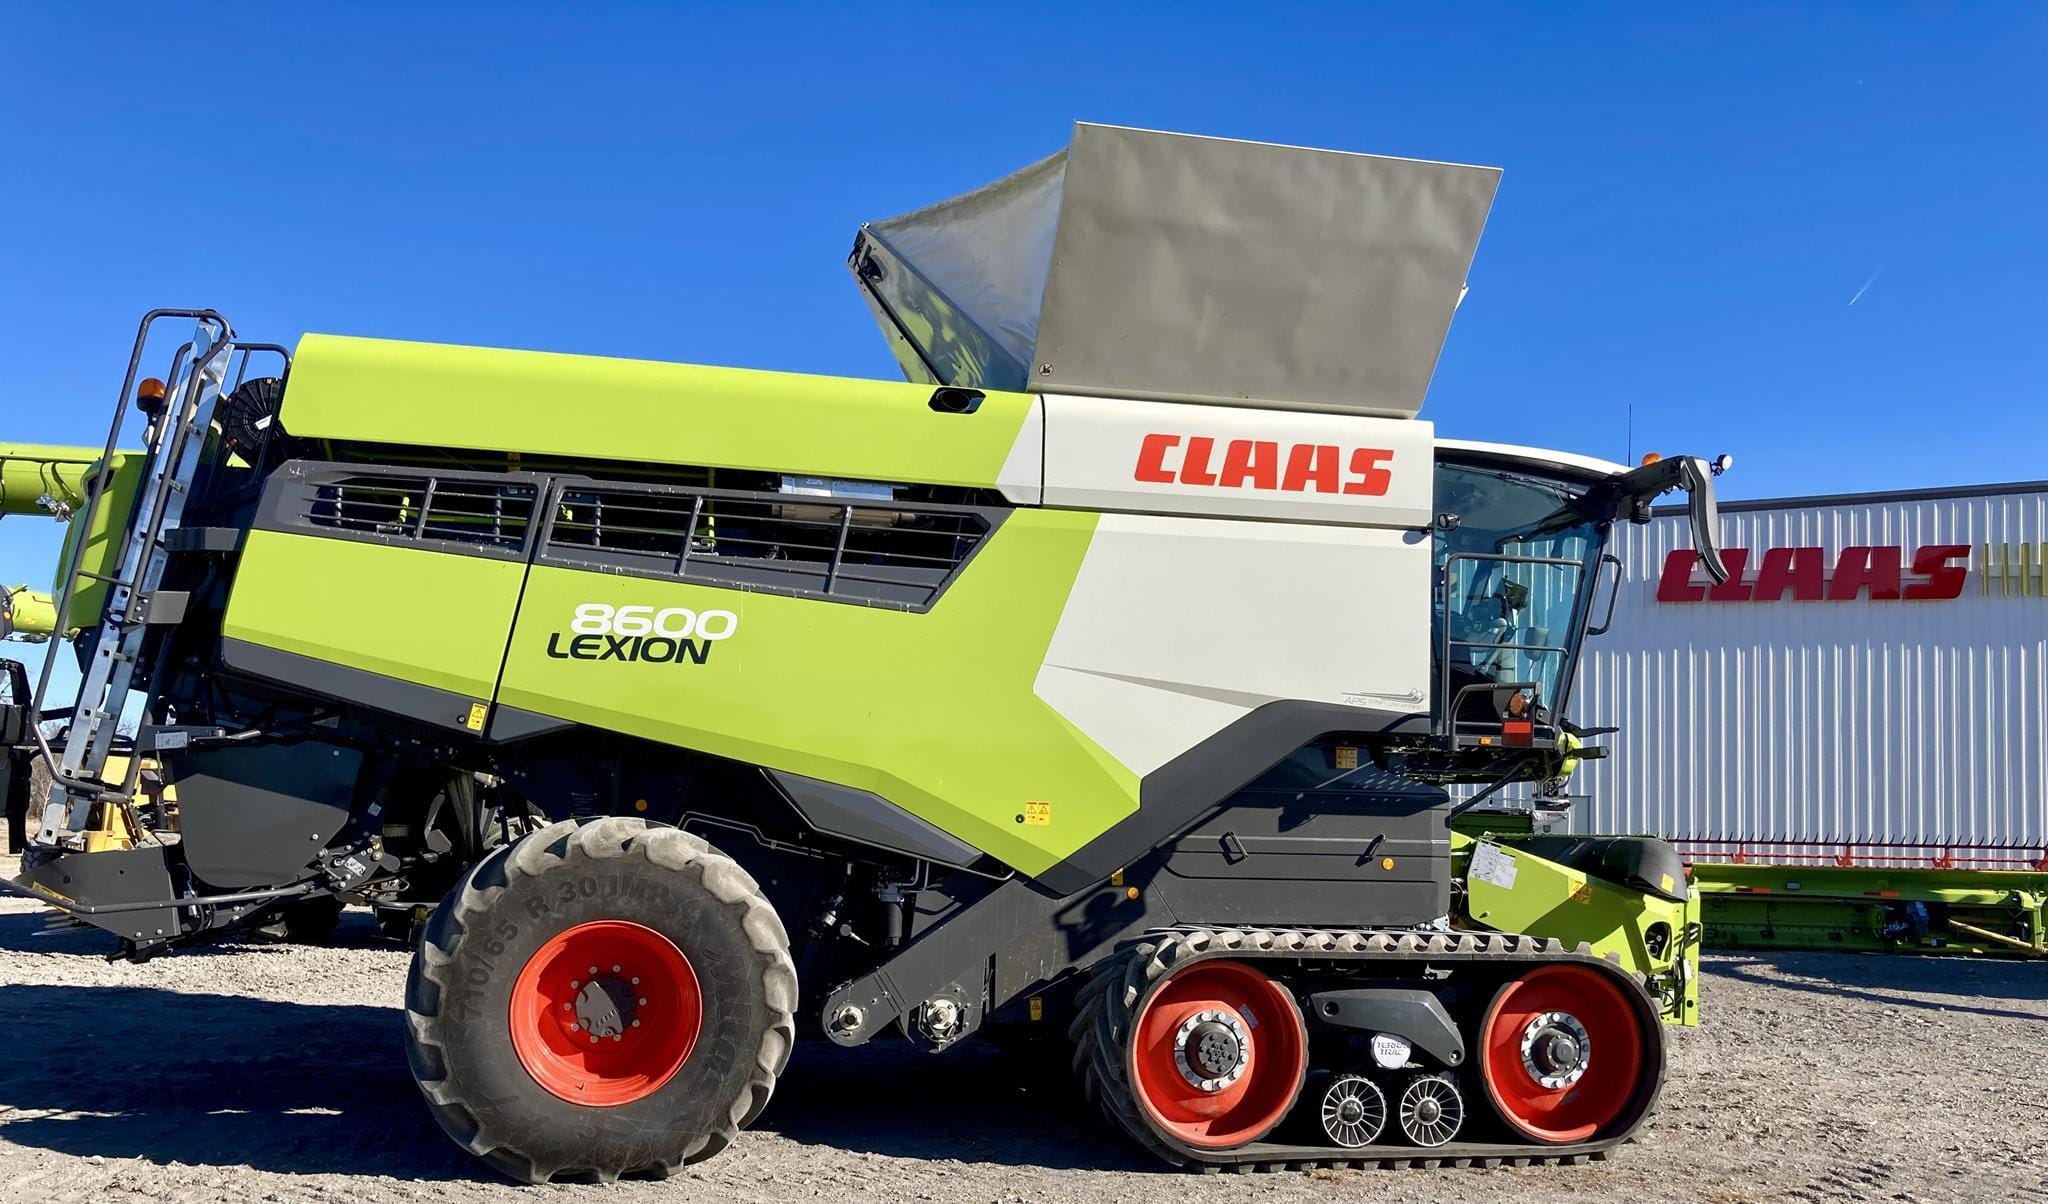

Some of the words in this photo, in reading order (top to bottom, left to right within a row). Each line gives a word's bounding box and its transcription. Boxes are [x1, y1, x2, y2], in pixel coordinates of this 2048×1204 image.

[1135, 434, 1394, 497] CLAAS
[1656, 545, 1972, 602] CLAAS
[571, 603, 738, 640] 8600
[547, 632, 712, 665] LEXION
[1344, 696, 1366, 707] APS
[522, 893, 551, 919] R
[556, 875, 598, 904] 30
